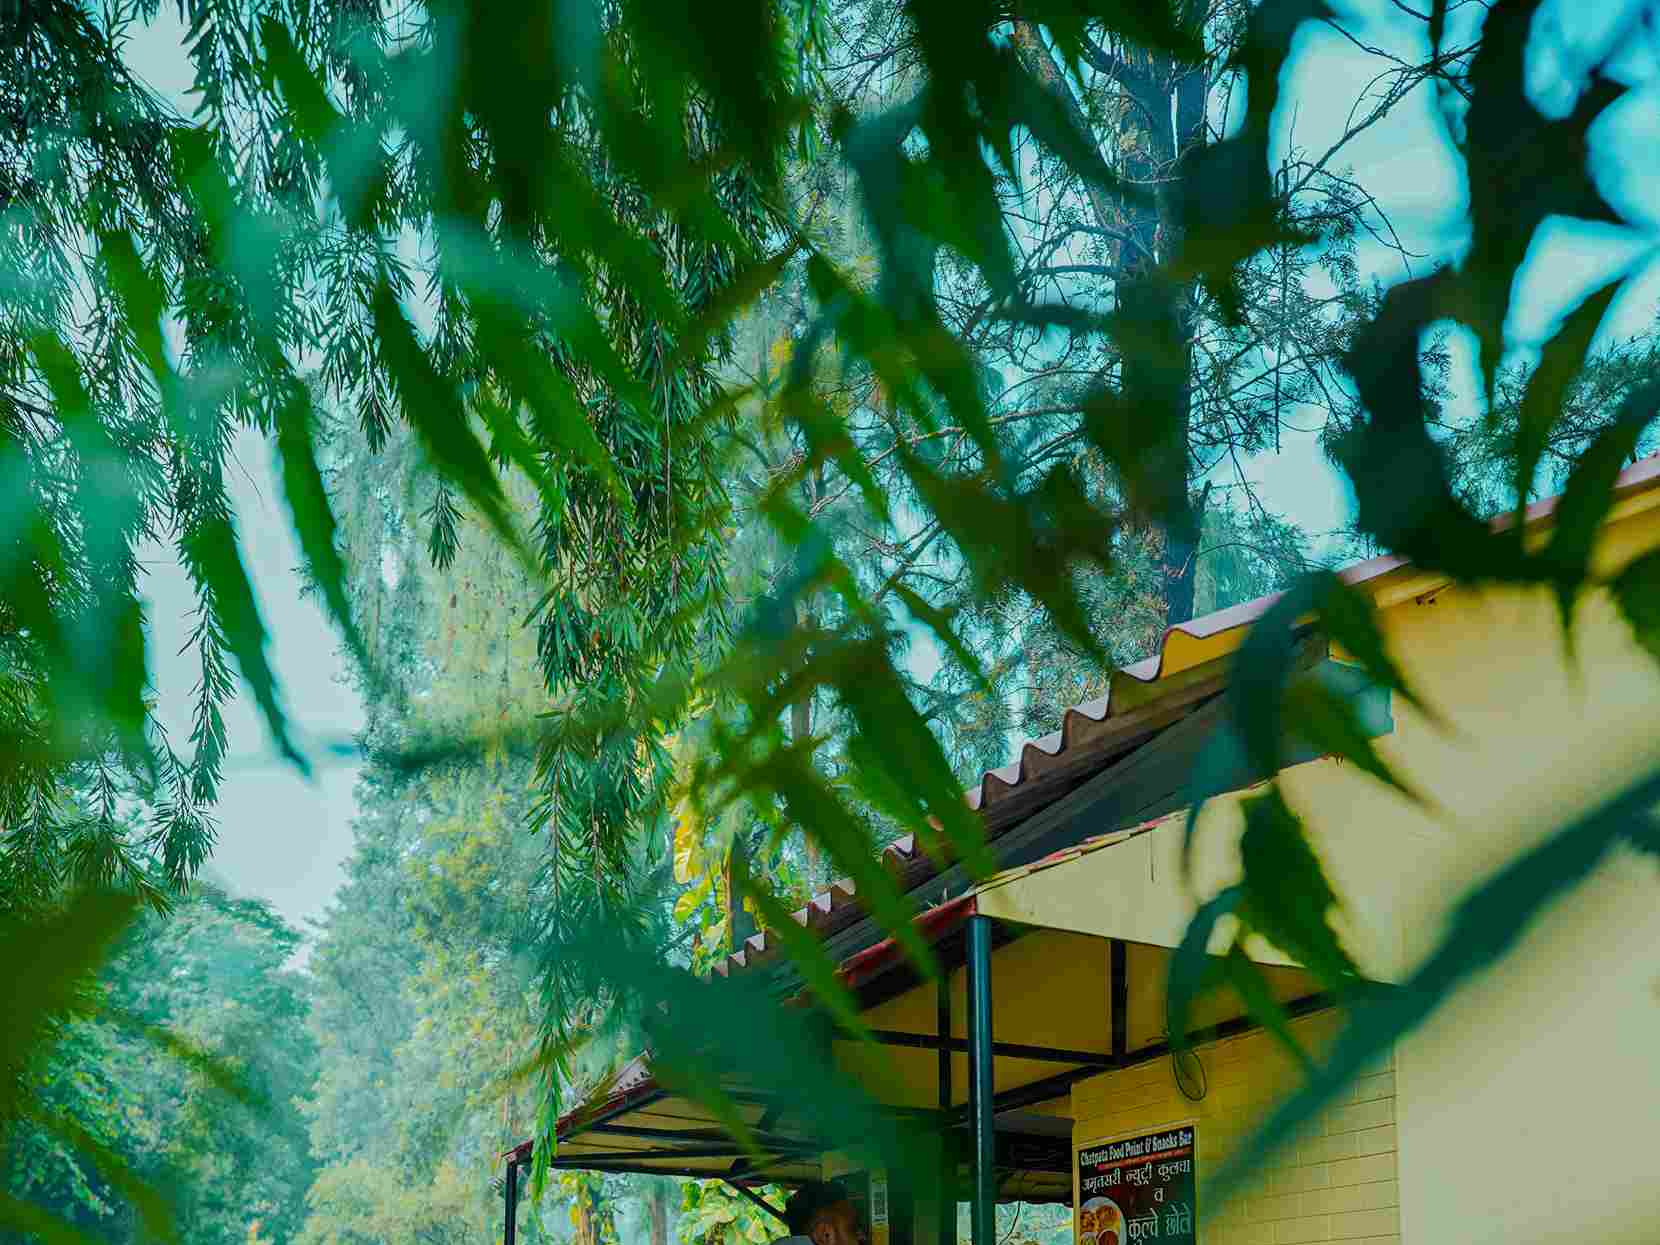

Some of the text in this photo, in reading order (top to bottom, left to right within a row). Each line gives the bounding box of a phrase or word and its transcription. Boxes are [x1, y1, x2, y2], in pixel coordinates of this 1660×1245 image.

[1109, 1143, 1124, 1160] Food
[1125, 1140, 1143, 1157] Point
[1152, 1132, 1178, 1152] Snacks
[1179, 1130, 1192, 1147] Bar
